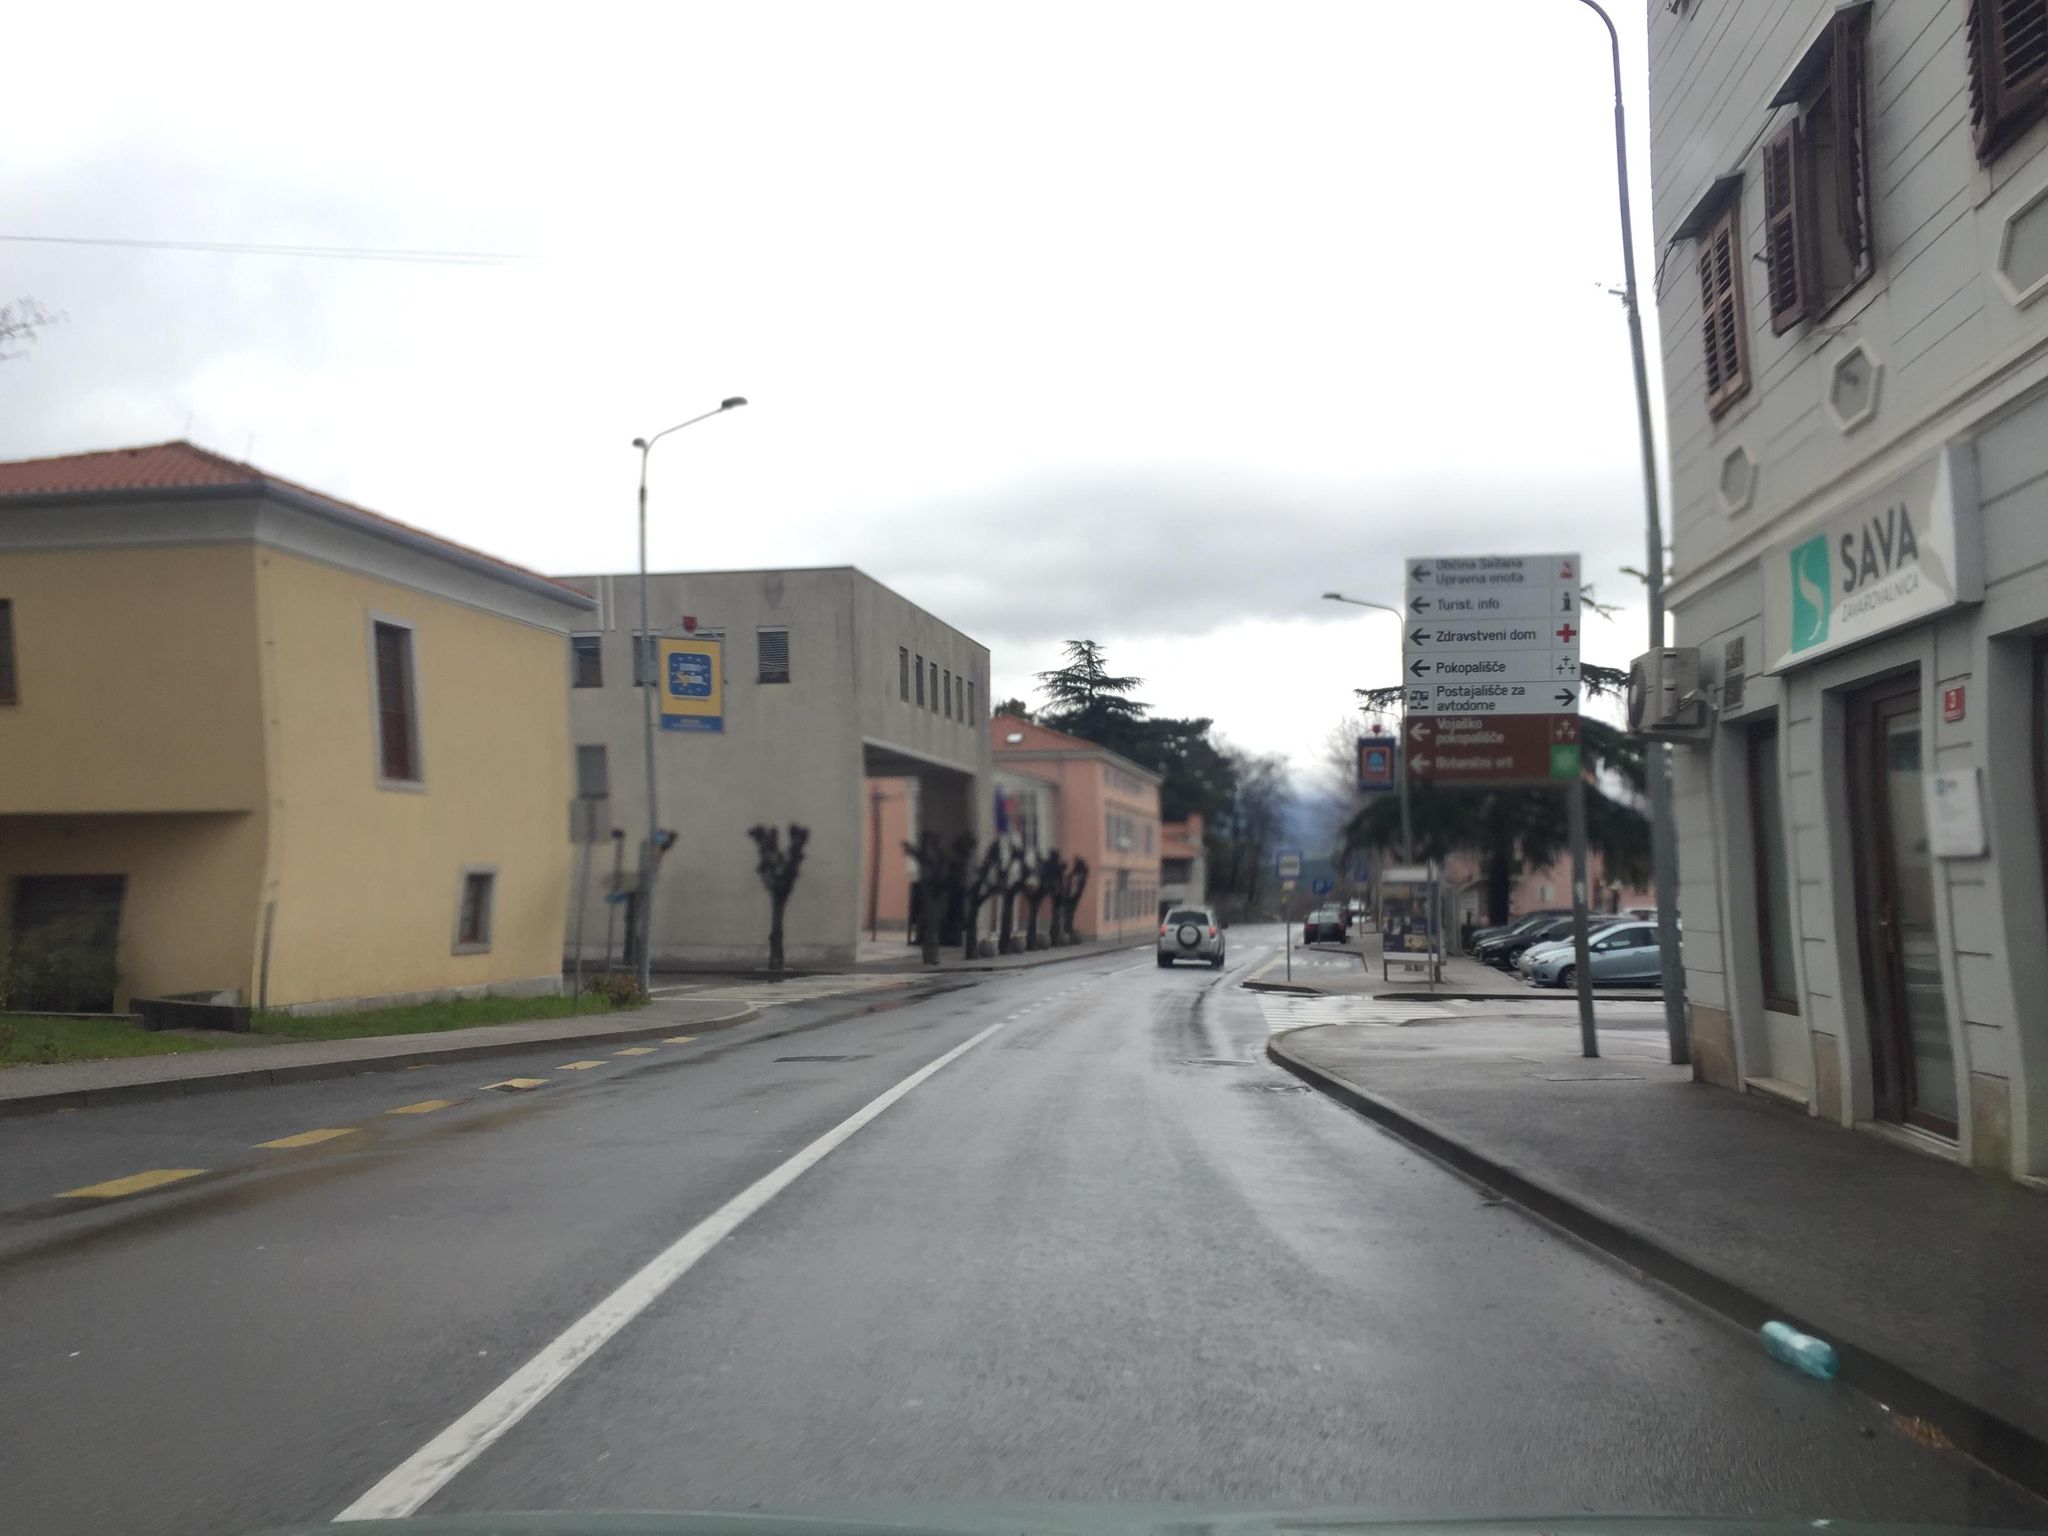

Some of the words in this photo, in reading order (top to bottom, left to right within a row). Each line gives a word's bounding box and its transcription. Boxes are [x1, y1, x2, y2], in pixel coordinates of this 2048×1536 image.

[1840, 503, 1919, 594] SAVA
[1436, 573, 1486, 586] Upravna
[1489, 573, 1524, 584] enota
[1437, 598, 1474, 611] Turist.
[1478, 597, 1500, 609] info
[1842, 574, 1919, 622] ZAVAROVALNICA
[1436, 630, 1507, 642] Zdravstveni
[1510, 629, 1537, 641] dom
[1436, 661, 1506, 676] Pokopališče
[1436, 685, 1508, 699] Postajališče
[1511, 686, 1525, 696] za
[1436, 700, 1496, 711] avtodome
[1436, 718, 1483, 732] Vojaško
